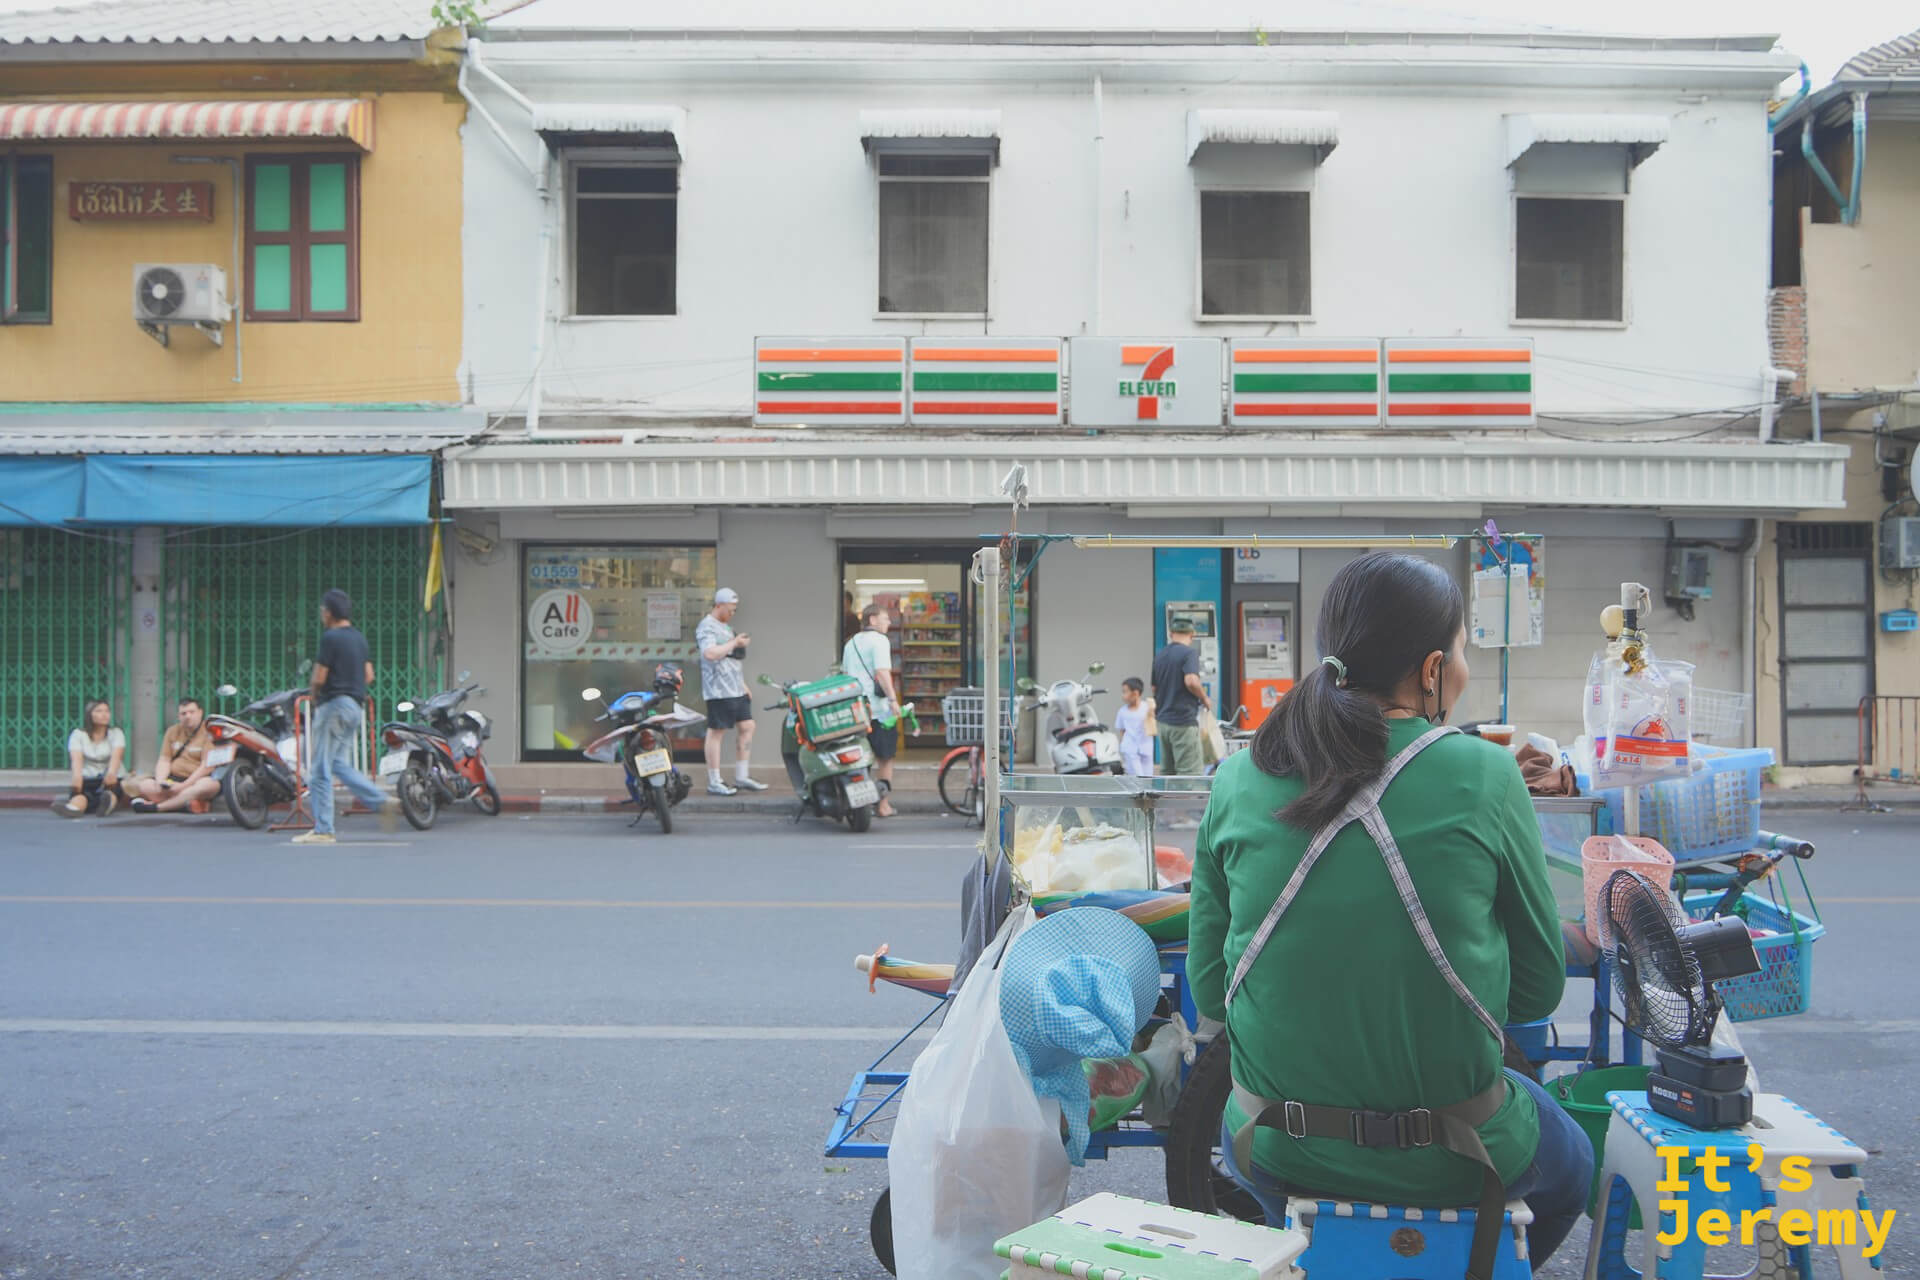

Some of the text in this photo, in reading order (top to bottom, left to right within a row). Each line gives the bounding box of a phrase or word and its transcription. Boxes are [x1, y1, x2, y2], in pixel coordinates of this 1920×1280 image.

[1121, 346, 1174, 419] 7
[1238, 546, 1260, 560] ttb
[531, 566, 578, 578] 01559
[543, 594, 580, 624] All
[542, 625, 580, 638] Cafe
